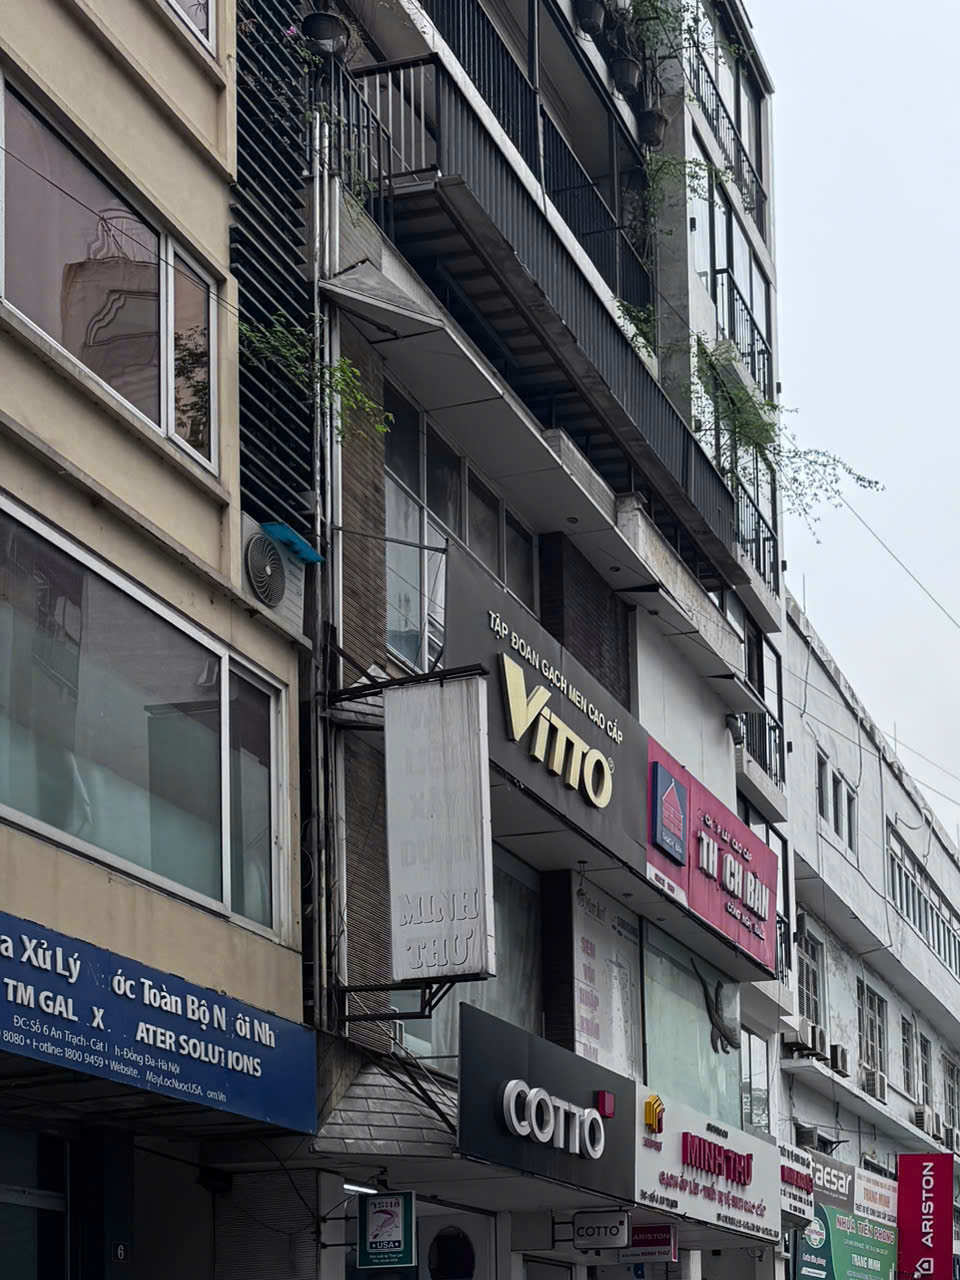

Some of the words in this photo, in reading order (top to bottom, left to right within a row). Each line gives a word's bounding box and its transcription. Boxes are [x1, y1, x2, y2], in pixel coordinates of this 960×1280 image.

[488, 610, 509, 639] TẬP
[541, 659, 567, 695] GẠCH
[568, 684, 587, 713] MEN
[588, 703, 606, 729] CAO
[606, 718, 623, 744] CẤP
[698, 831, 743, 899] THCH
[400, 888, 479, 926] MINH
[4, 978, 35, 1008] TM
[136, 1022, 176, 1052] ATER
[56, 947, 80, 984] Lý
[112, 969, 136, 999] ớc
[140, 978, 182, 1015] Toàn
[186, 994, 210, 1031] Bộ
[253, 1019, 276, 1048] Nh
[42, 1024, 49, 1035] 6
[50, 1026, 62, 1040] An
[64, 1048, 82, 1062] 1800
[84, 1053, 104, 1068] 9459
[503, 1078, 606, 1160] COTTO
[682, 1131, 724, 1176] MINH
[921, 1162, 935, 1248] ARISTON
[376, 1241, 394, 1249] USA
[576, 1225, 620, 1237] COTTO
[632, 1232, 670, 1241] ARISTON
